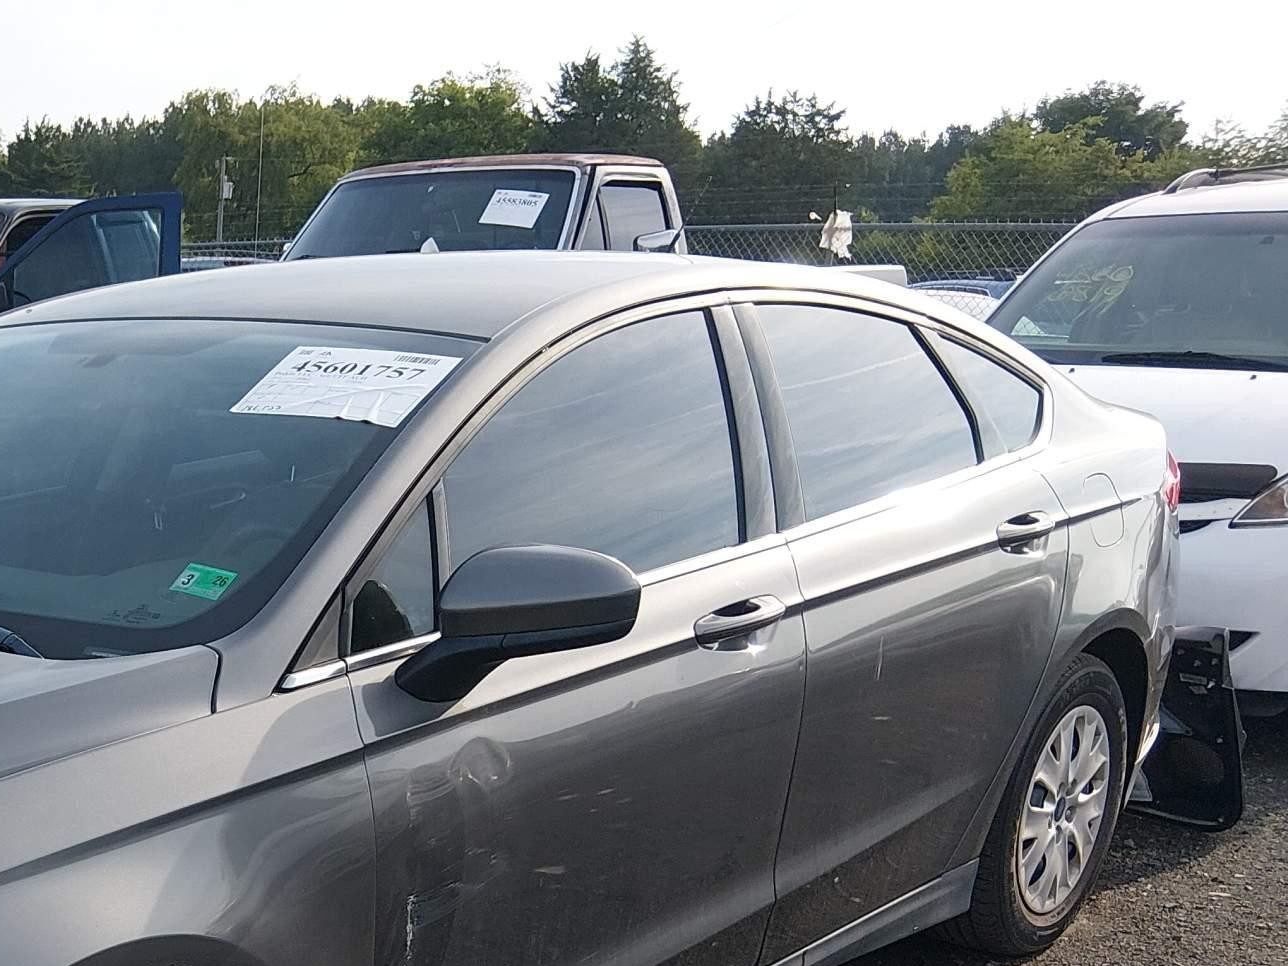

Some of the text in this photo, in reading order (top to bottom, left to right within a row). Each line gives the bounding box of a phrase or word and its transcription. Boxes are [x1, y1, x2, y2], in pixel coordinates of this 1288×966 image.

[291, 359, 427, 380] 45601757
[181, 574, 230, 588] 3 26
